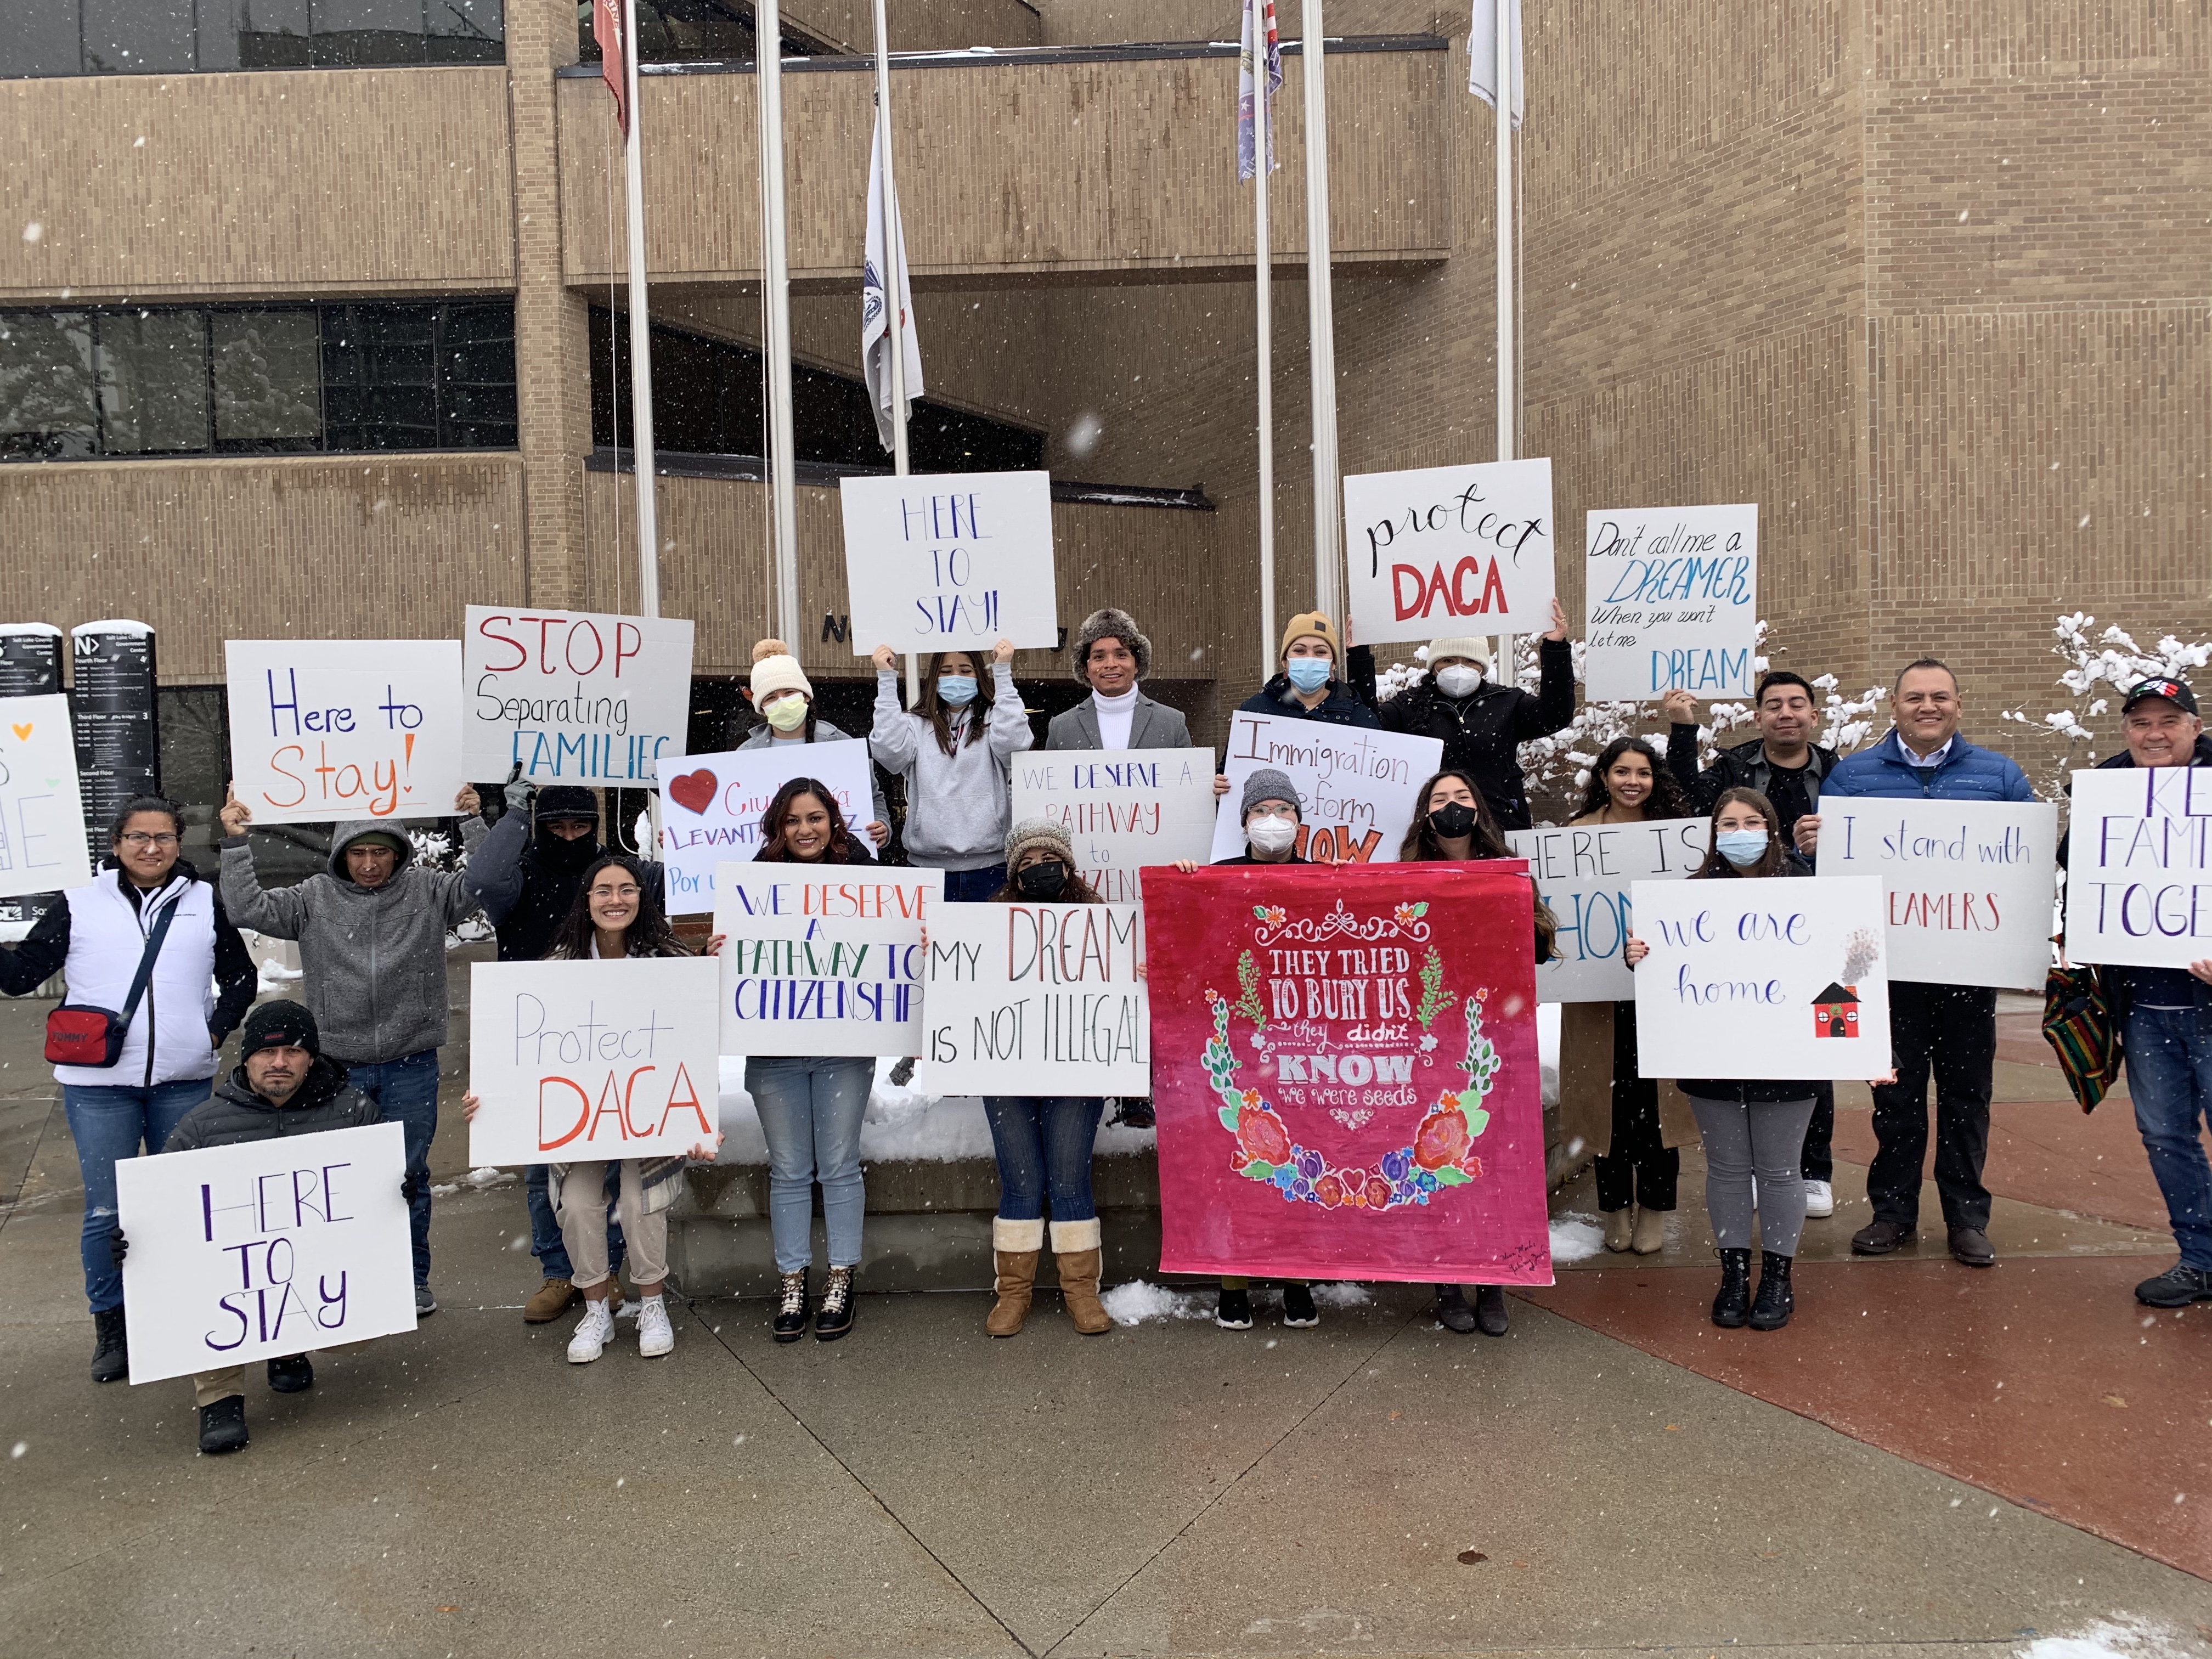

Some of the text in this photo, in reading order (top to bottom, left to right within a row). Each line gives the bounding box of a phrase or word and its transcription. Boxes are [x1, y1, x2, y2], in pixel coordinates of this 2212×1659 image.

[902, 493, 992, 541] HERE
[1367, 483, 1548, 578] protect
[1588, 522, 1742, 556] Don't call me a
[928, 548, 969, 586] TO
[1392, 555, 1509, 621] DACA
[1603, 556, 1750, 605] DREAMER
[916, 590, 997, 635] STAY!
[1591, 606, 1642, 624] When
[1643, 612, 1672, 629] you
[75, 636, 91, 656] N
[479, 616, 641, 678] STOP
[1588, 630, 1637, 647] let me
[1650, 648, 1754, 697] DREAM
[268, 668, 423, 737] Here to
[477, 674, 628, 736] Separating
[1233, 719, 1409, 785] Immigration
[264, 734, 416, 816] Stay!
[1023, 761, 1193, 790] WE DESERVE A
[1045, 802, 1160, 834] PATHWAY
[1296, 781, 1375, 827] eform
[1089, 839, 1110, 863] to
[1649, 825, 1707, 873] IS
[1843, 816, 2030, 864] I stand with
[669, 867, 700, 896] Por
[736, 884, 936, 921] WE DESERVE
[806, 918, 825, 940] A
[1656, 910, 1812, 947] we are
[1889, 891, 2000, 932] EAMERS
[737, 939, 926, 980] PATHWAY TO
[932, 907, 1137, 985] MY DREAM
[1269, 947, 1409, 975] THEY TRIED
[735, 979, 924, 1022] CITIZENSHIP
[1268, 978, 1299, 1019] TO
[1304, 978, 1369, 1020] BURY
[1673, 963, 1786, 1006] home
[52, 1031, 88, 1042] TOMMY
[516, 994, 674, 1065] Protect
[932, 994, 1149, 1066] IS NOT ILLEGAL
[1294, 1019, 1342, 1054] they
[1277, 1054, 1415, 1086] KNOW
[539, 1062, 712, 1151] DACA
[1278, 1084, 1417, 1106] we were seeds
[201, 1163, 354, 1242] HERE
[222, 1238, 294, 1289] TO
